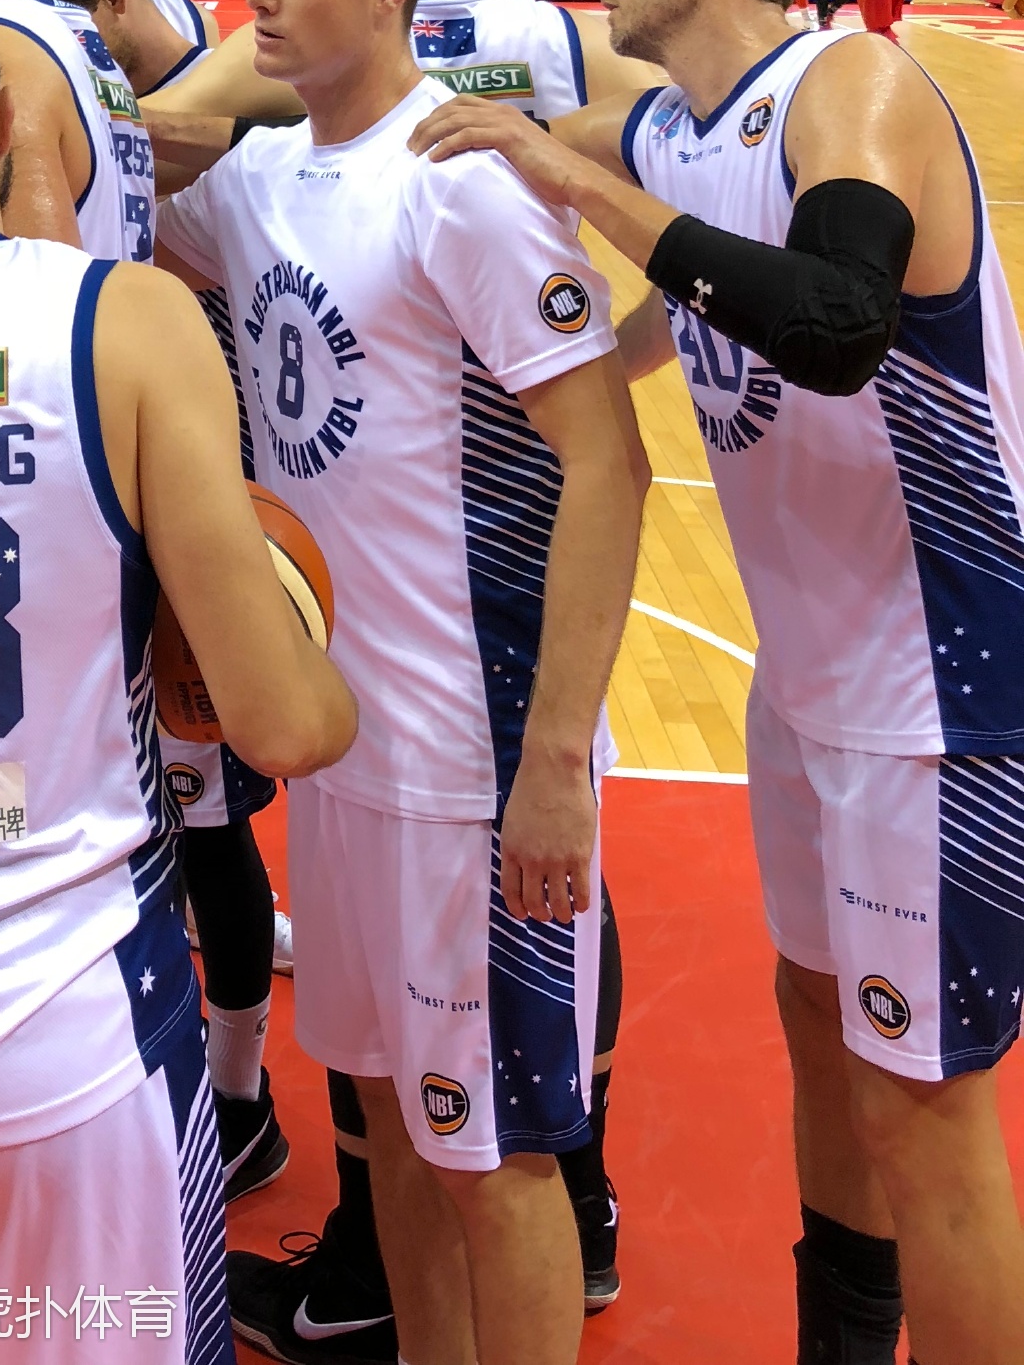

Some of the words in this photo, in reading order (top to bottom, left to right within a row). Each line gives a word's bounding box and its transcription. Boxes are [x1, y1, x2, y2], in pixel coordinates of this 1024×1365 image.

[451, 68, 521, 93] WEST
[244, 260, 328, 345] AUSTRALIAN
[317, 305, 367, 371] NBL
[549, 288, 581, 319] NBL
[276, 322, 305, 421] 8
[316, 396, 364, 460] NBL
[171, 774, 195, 793] NBL
[857, 896, 888, 914] FIRST
[894, 907, 928, 923] EVER
[417, 992, 445, 1010] FIRST
[451, 1000, 481, 1012] EVER
[868, 990, 896, 1024] NBL
[427, 1088, 457, 1117] NBL
